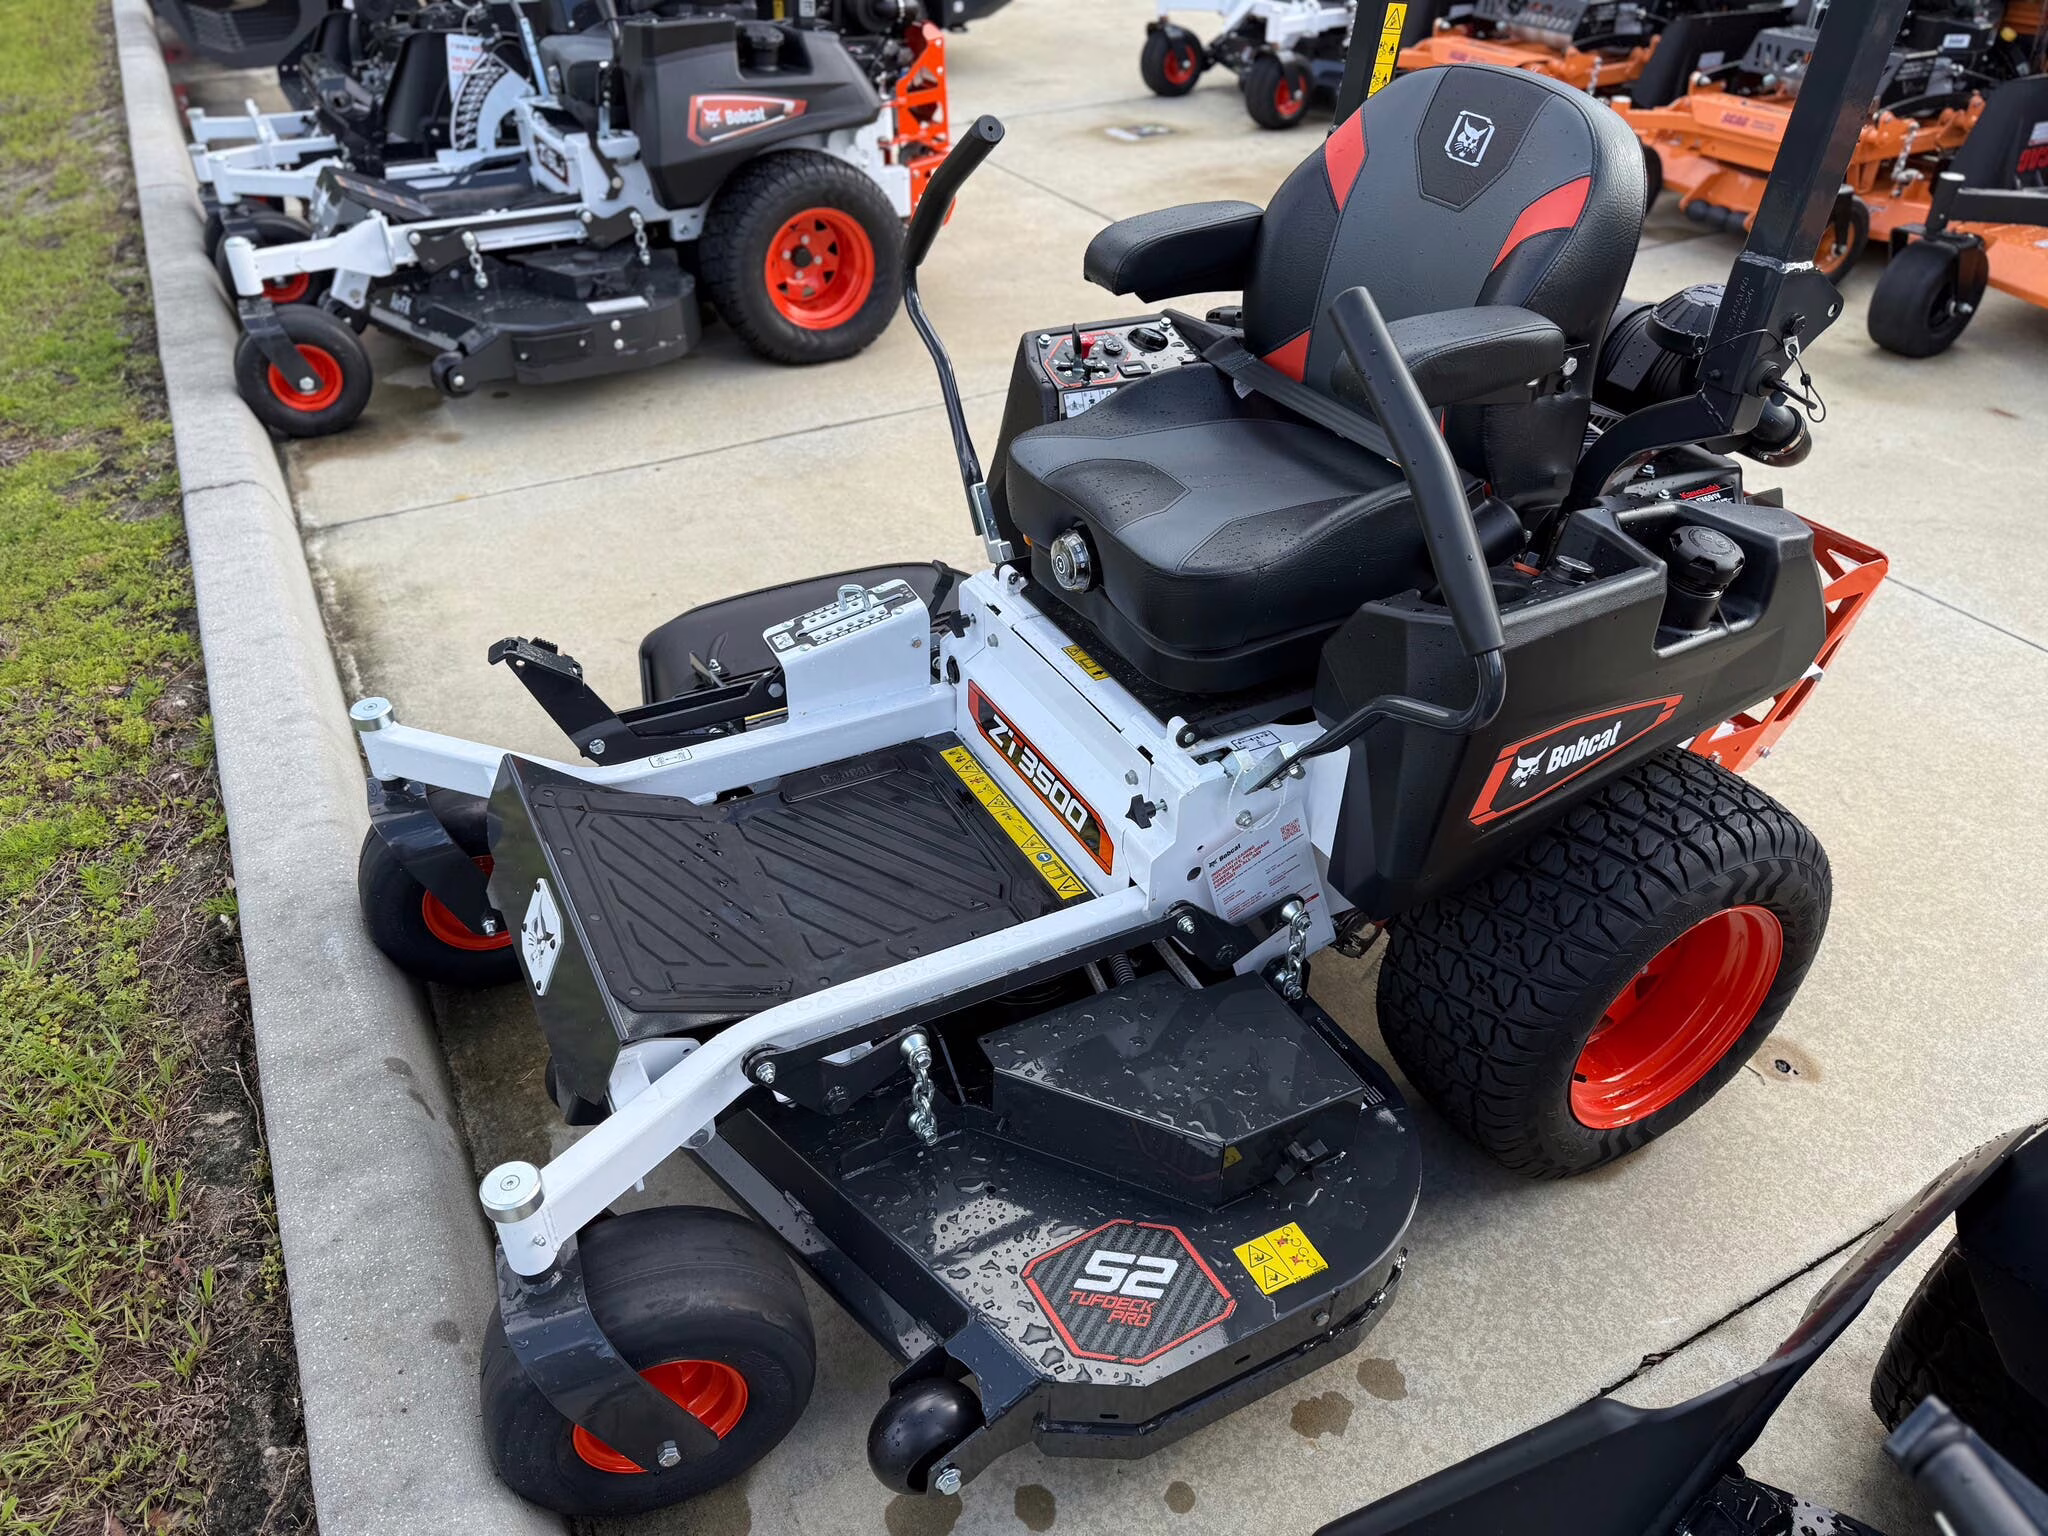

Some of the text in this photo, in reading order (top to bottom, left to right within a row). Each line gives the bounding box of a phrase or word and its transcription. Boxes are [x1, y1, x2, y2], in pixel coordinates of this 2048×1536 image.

[725, 106, 765, 125] Bobcat
[1680, 483, 1721, 499] Kawasaki
[1546, 720, 1622, 775] Bobcat
[988, 714, 1088, 832] ZT3500
[1219, 843, 1241, 861] Bobcat
[1068, 1290, 1158, 1313] TUFDECK
[1107, 1311, 1152, 1328] PRO
